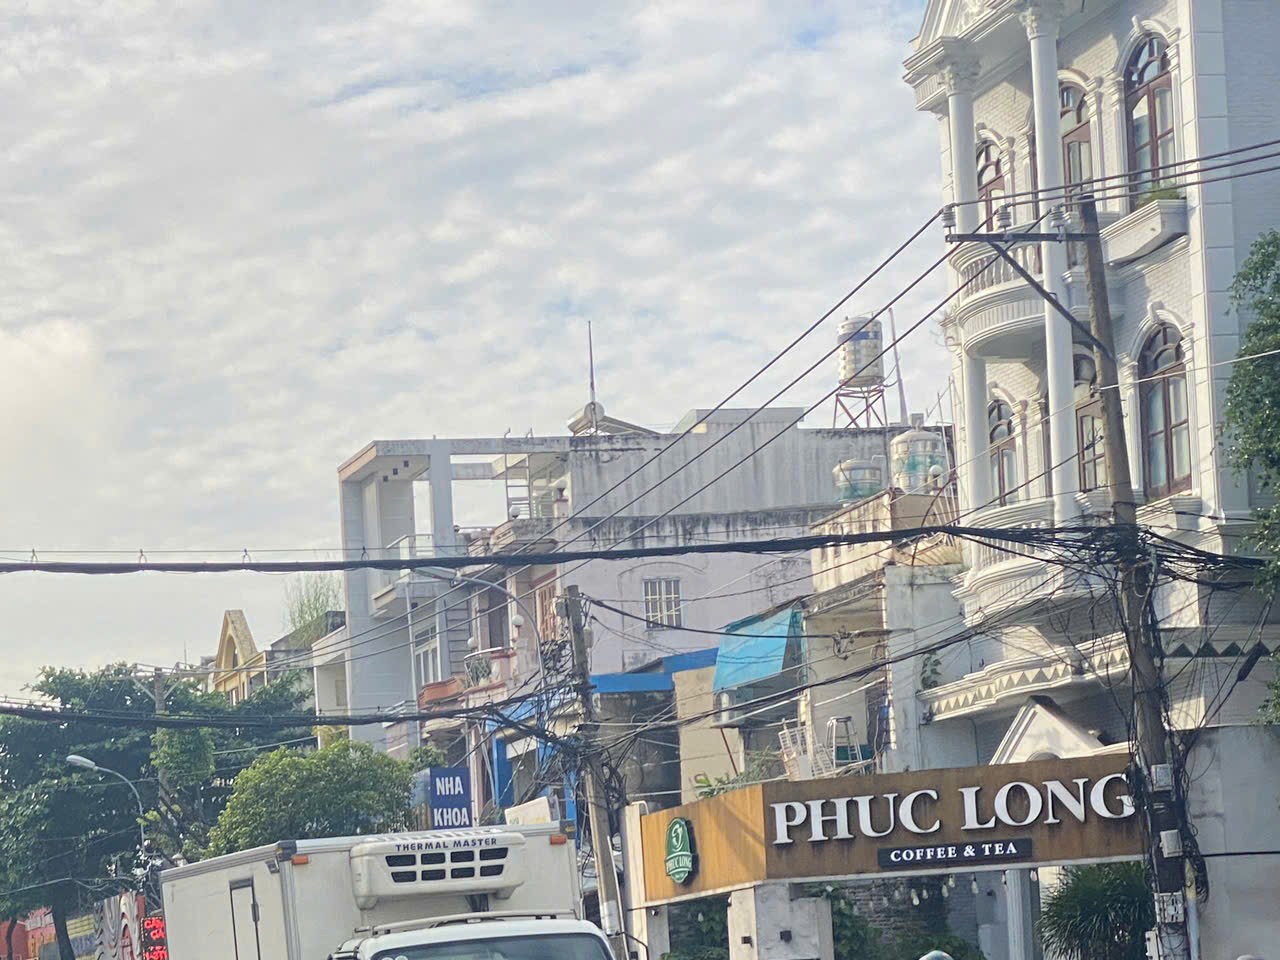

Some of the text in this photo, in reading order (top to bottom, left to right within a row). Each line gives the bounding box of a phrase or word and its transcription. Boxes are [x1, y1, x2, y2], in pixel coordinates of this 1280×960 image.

[435, 776, 464, 796] NHA
[433, 807, 470, 827] KHOA
[770, 773, 1136, 845] PHUC LONG
[395, 837, 497, 852] THERMAL MASTER
[890, 841, 1018, 863] COFFEE & TEA
